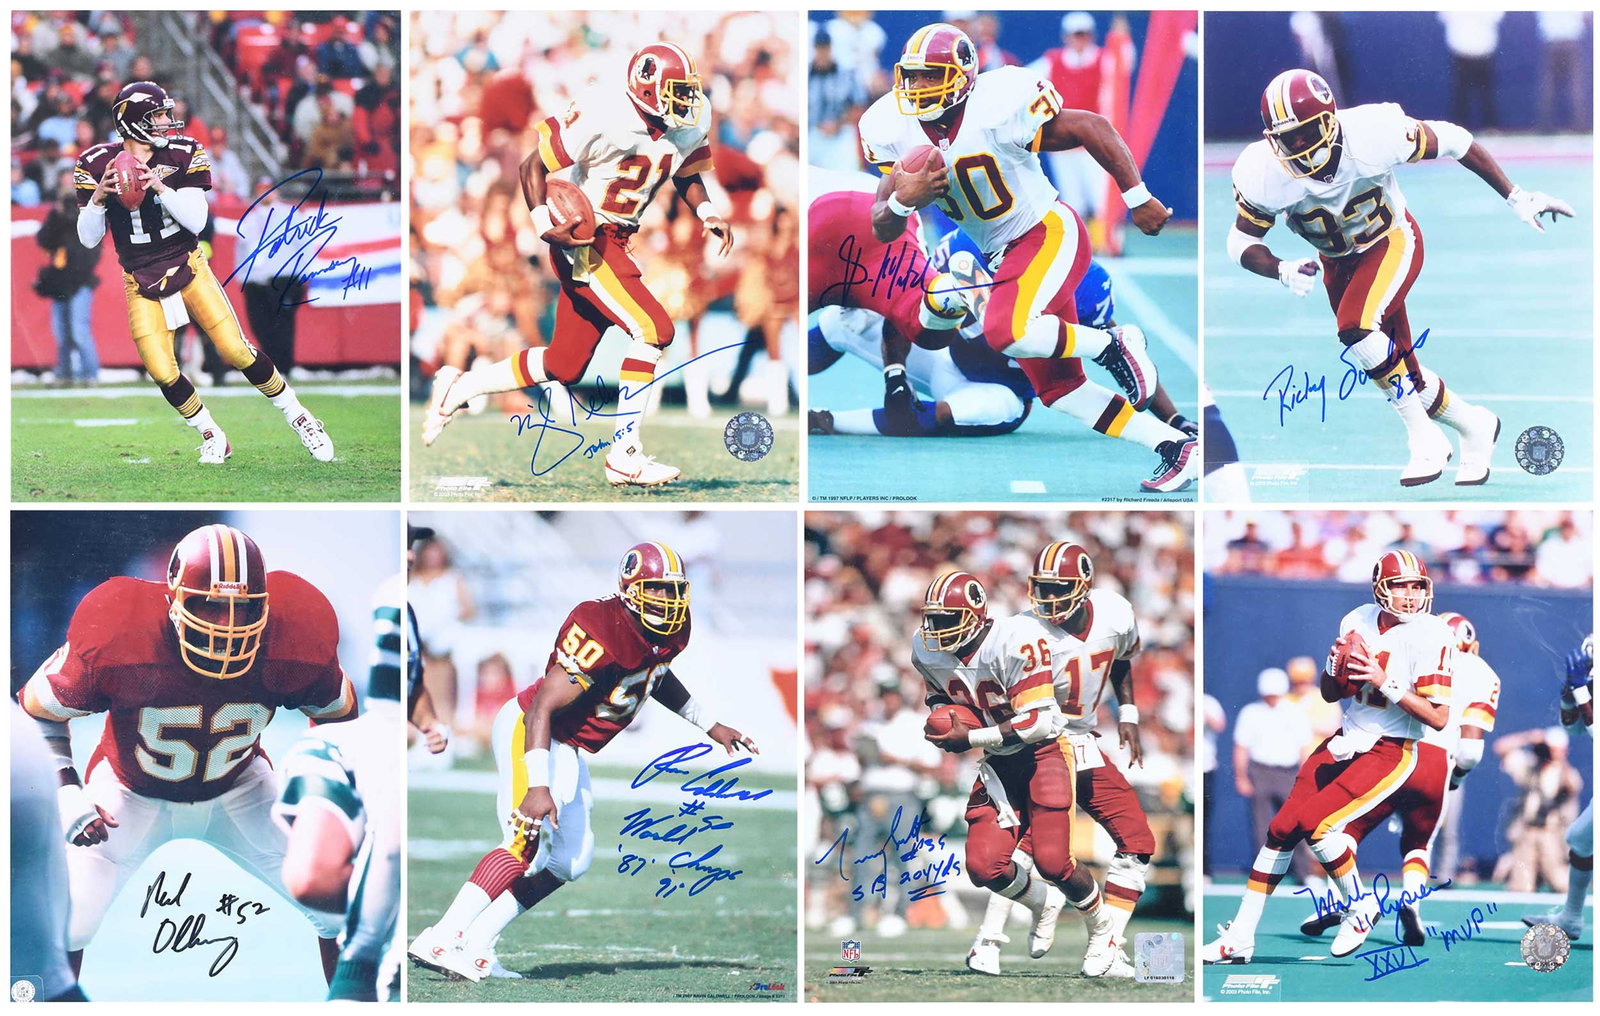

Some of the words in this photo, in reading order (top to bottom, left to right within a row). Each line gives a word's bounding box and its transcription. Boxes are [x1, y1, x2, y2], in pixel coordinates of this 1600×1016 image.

[600, 153, 675, 219] 21
[222, 168, 343, 292] Patrick
[1263, 364, 1326, 427] Ricky
[583, 438, 611, 460] John
[562, 622, 605, 670] 50
[1020, 638, 1052, 673] 36
[1061, 647, 1116, 720] 17
[134, 702, 275, 784] 52
[215, 893, 271, 925] #52
[1355, 943, 1430, 981] XXVI
